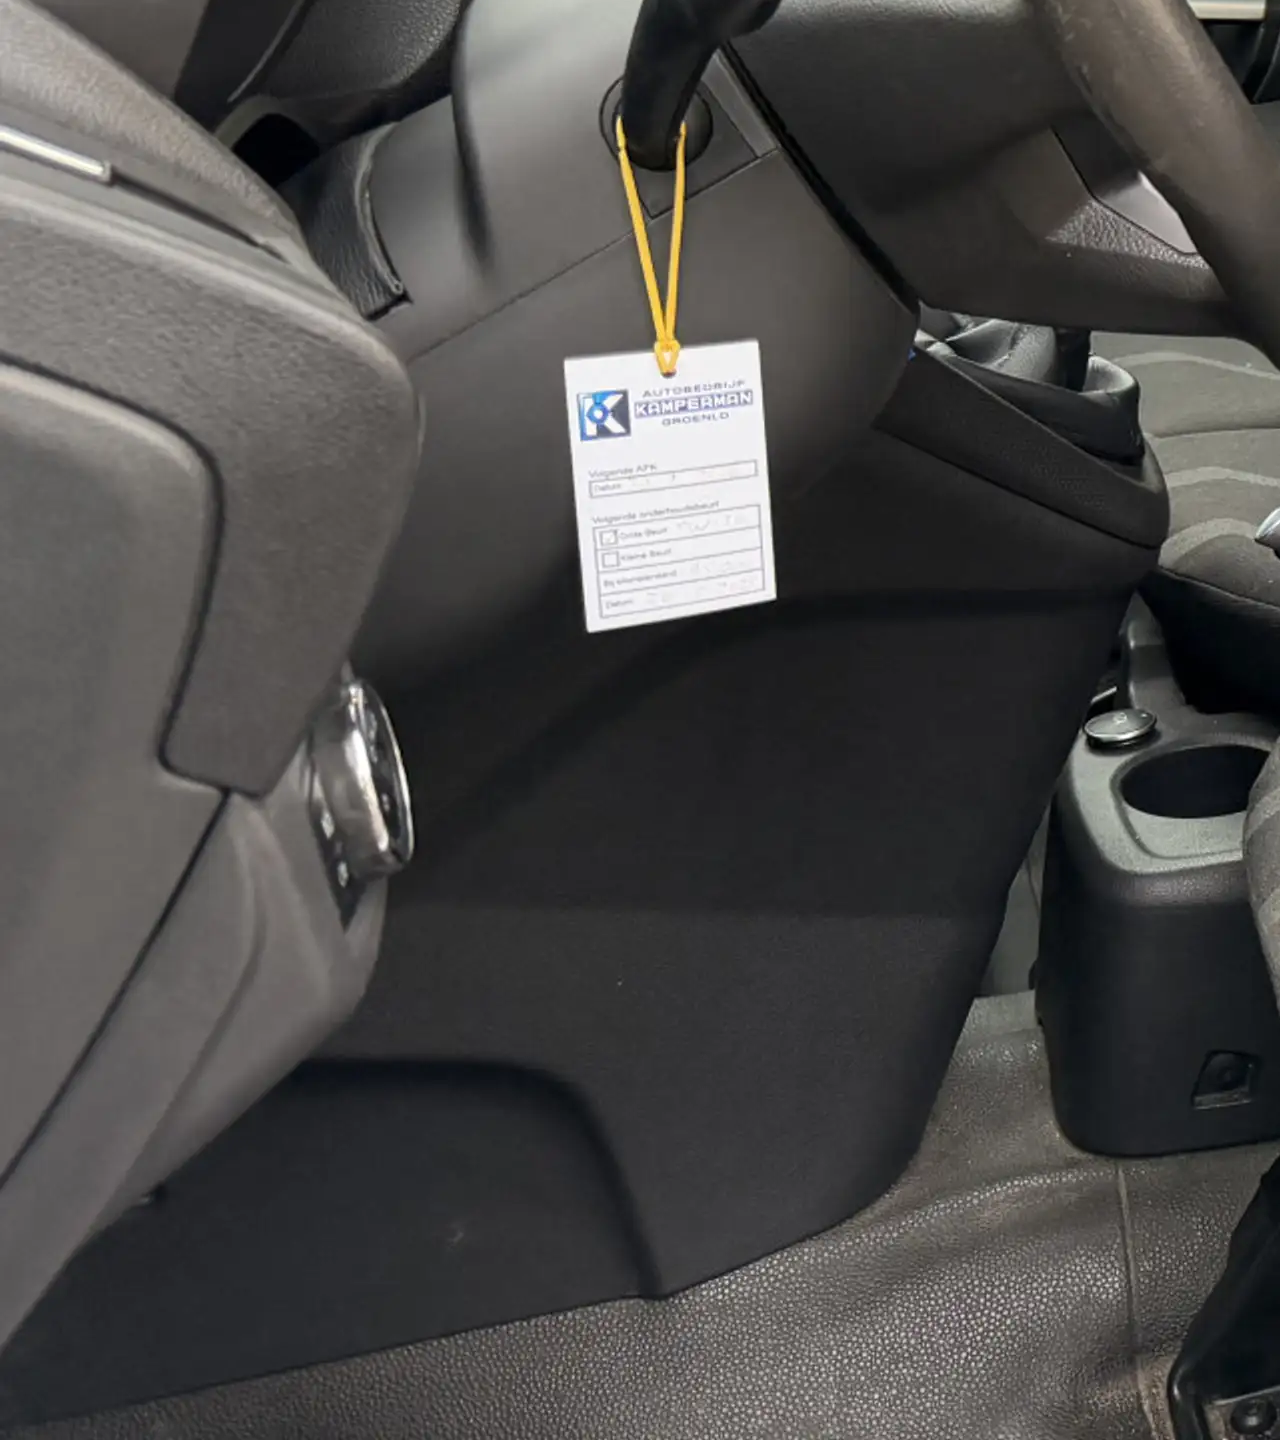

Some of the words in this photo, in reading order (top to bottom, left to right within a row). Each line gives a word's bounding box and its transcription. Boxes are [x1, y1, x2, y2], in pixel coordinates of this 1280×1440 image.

[642, 380, 746, 398] AUTOBEDRIJF
[634, 390, 753, 417] KAMPERMAN
[661, 412, 730, 427] GROENLO
